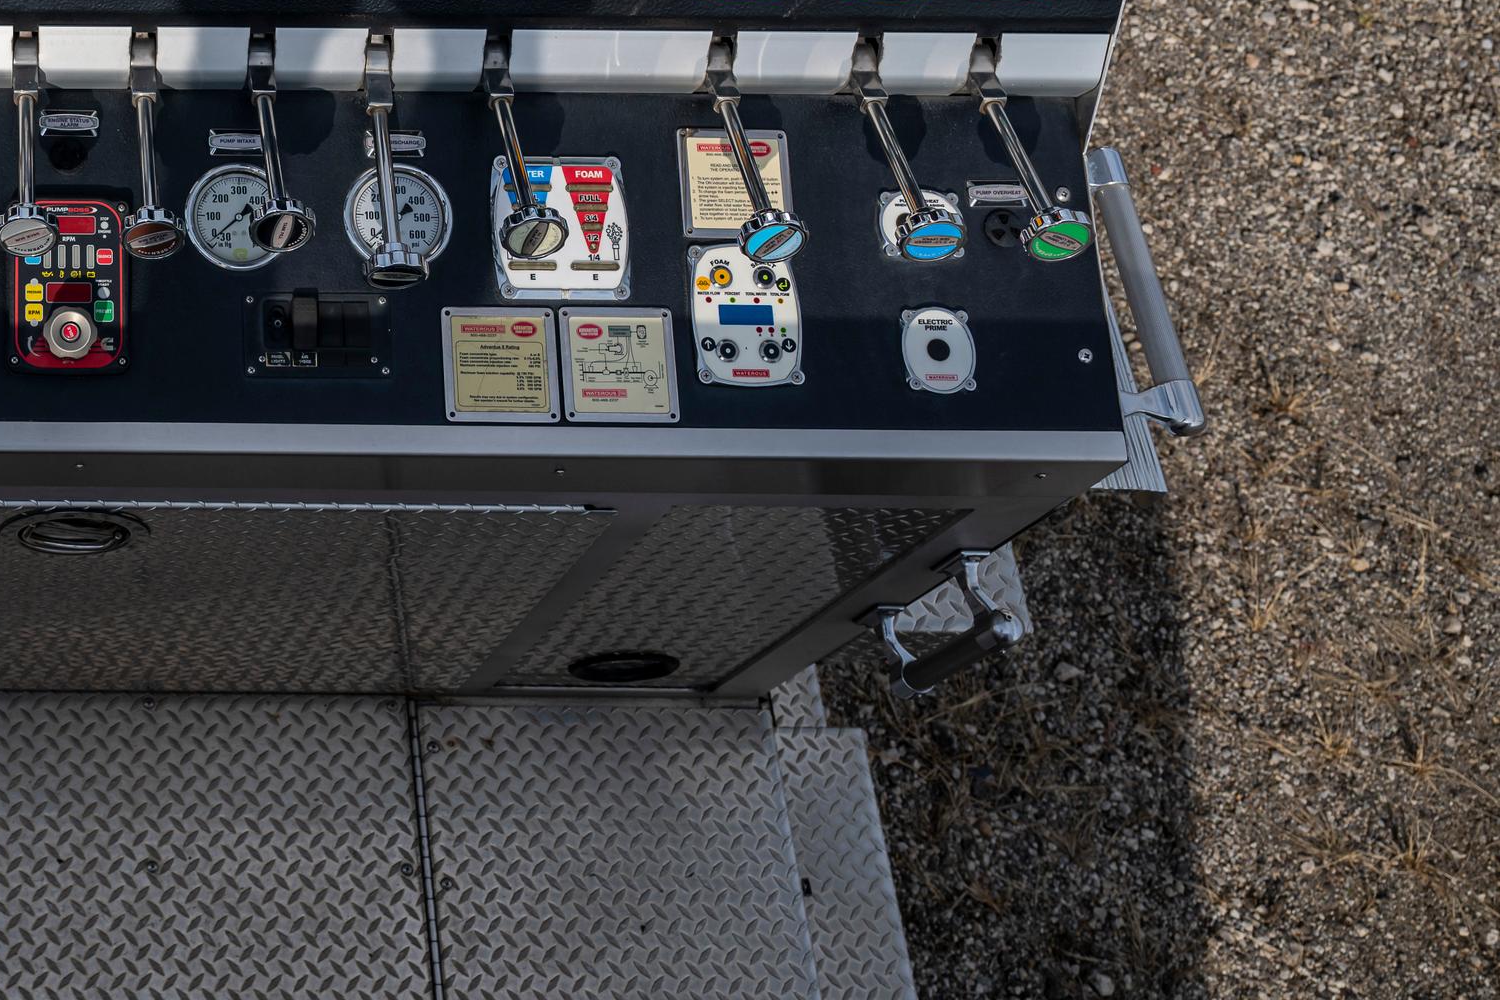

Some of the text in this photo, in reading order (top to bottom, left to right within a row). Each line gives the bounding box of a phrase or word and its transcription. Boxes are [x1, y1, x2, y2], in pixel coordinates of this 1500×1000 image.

[231, 185, 247, 195] 300
[212, 194, 229, 203] 200
[249, 196, 266, 205] 400
[408, 196, 425, 205] 400
[206, 211, 221, 221] 100
[365, 211, 379, 220] 100
[414, 213, 430, 222] 500
[211, 228, 217, 237] 0
[370, 228, 376, 237] 0
[409, 230, 426, 239] 600
